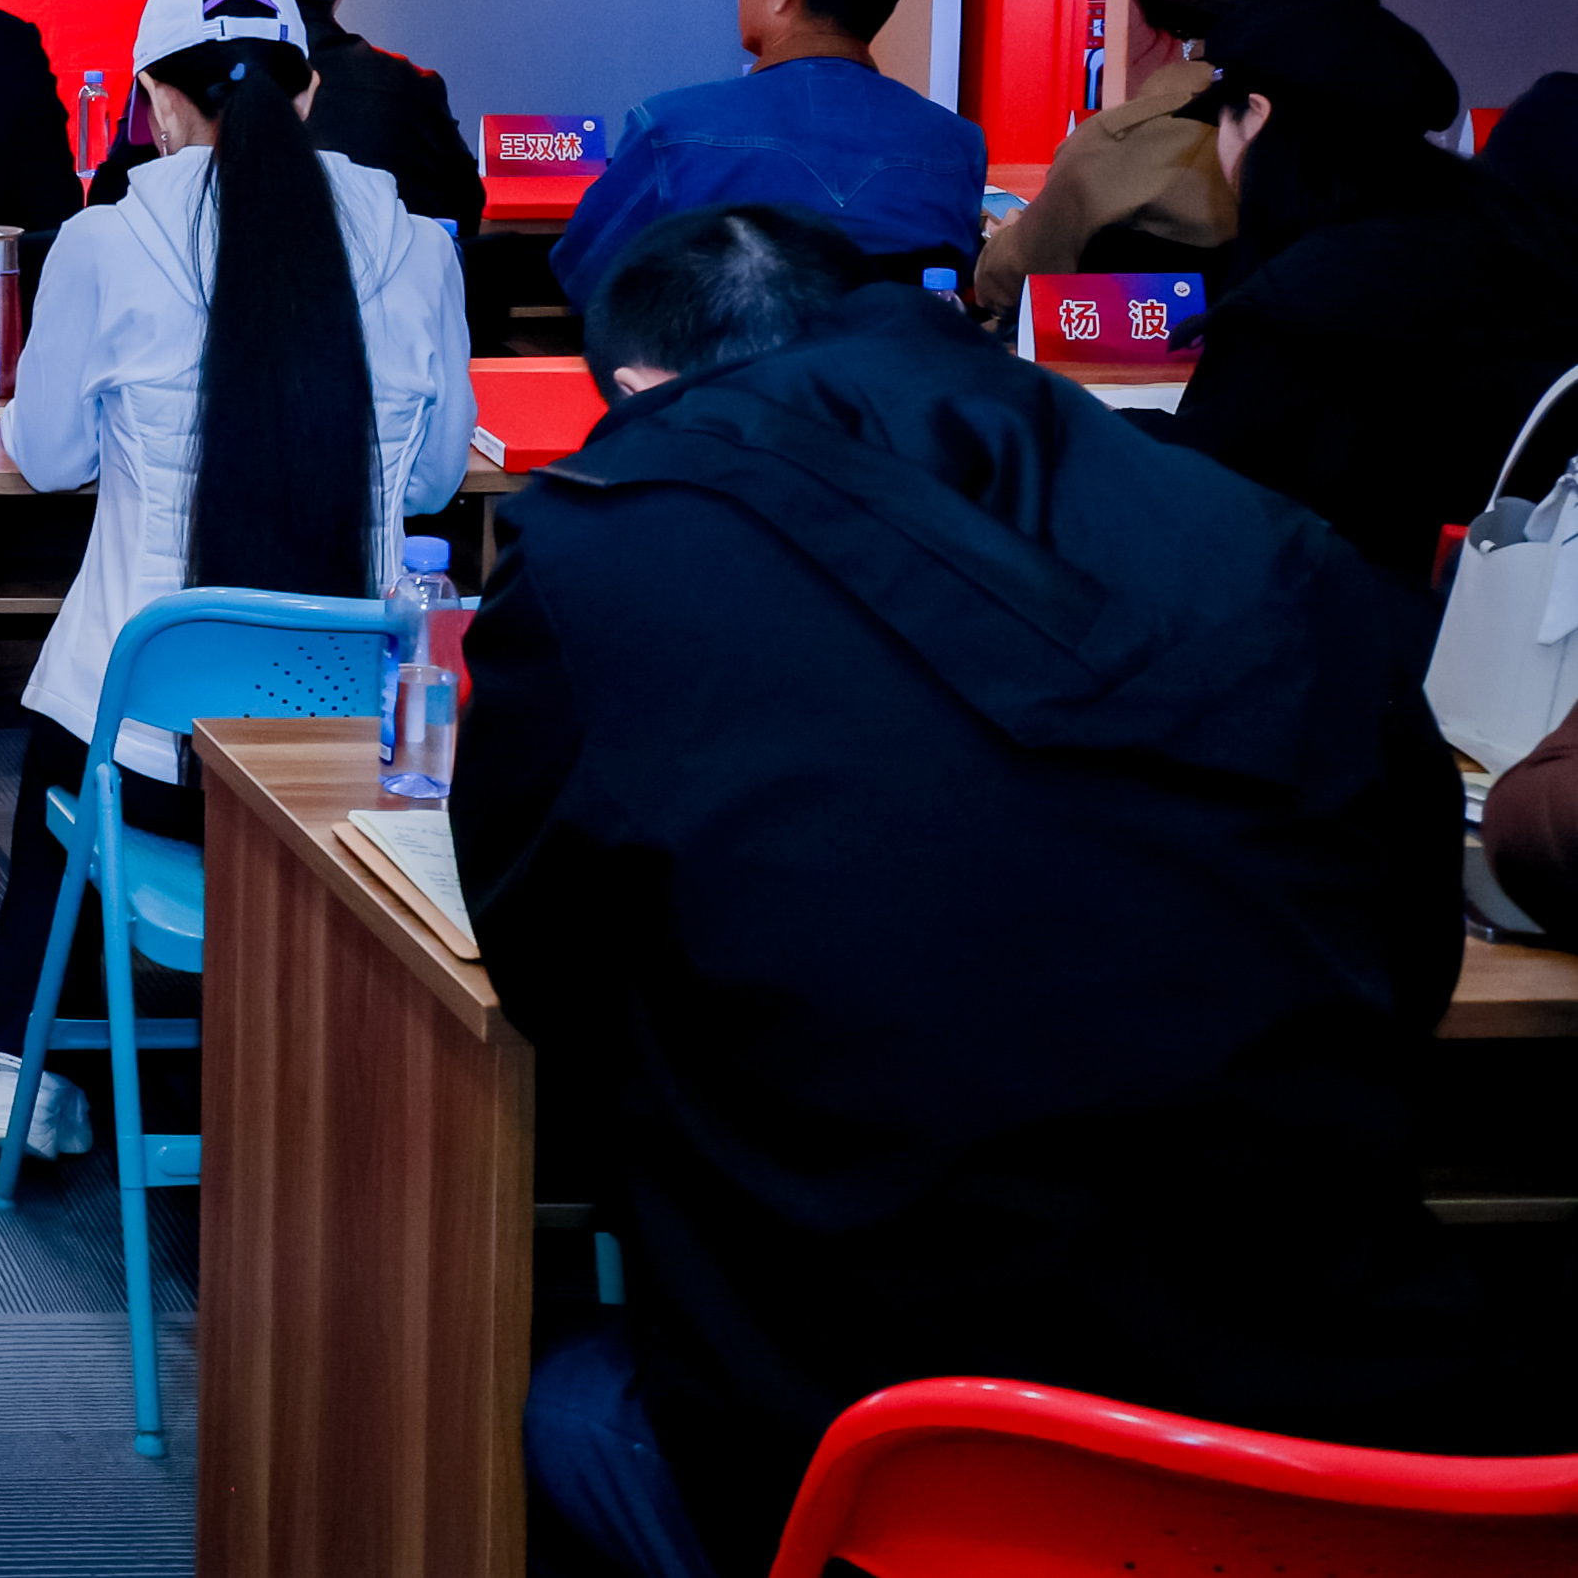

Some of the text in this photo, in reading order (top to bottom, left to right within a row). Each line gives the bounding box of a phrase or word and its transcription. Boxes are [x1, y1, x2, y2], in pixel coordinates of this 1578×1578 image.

[500, 132, 583, 161] 王双林
[1059, 299, 1170, 340] 杨波
